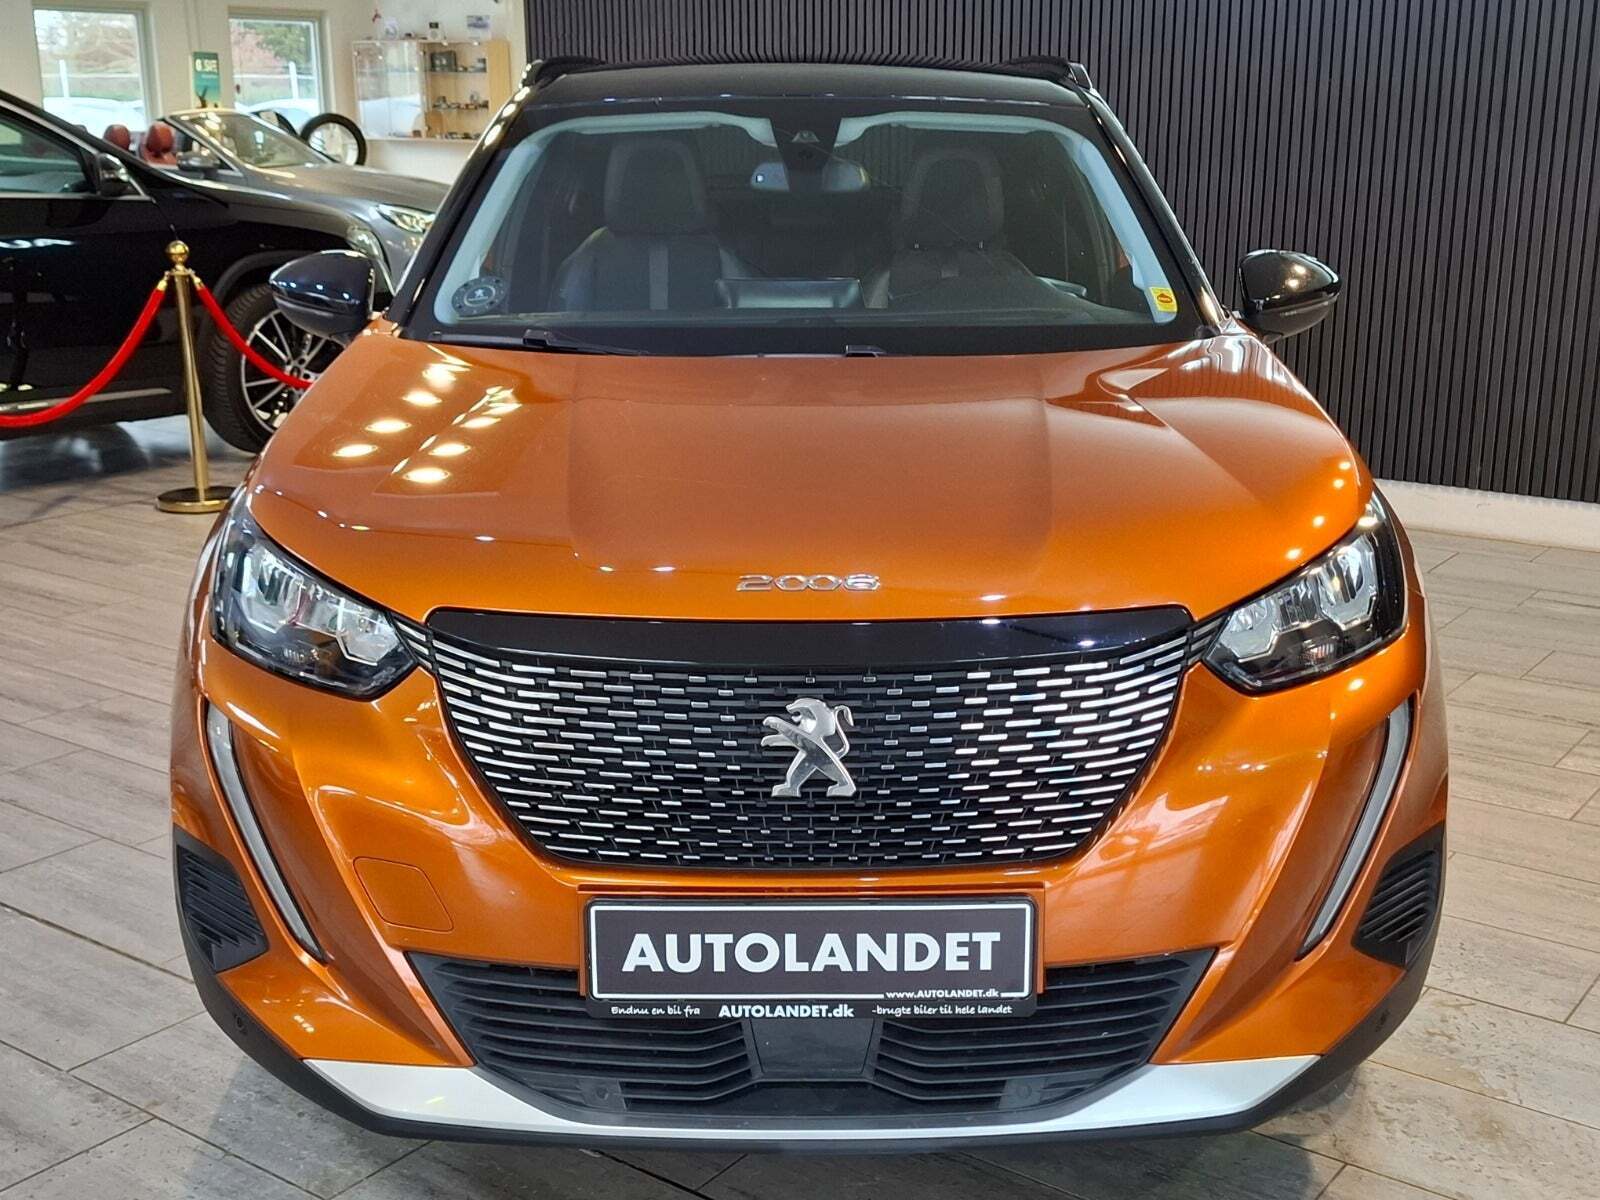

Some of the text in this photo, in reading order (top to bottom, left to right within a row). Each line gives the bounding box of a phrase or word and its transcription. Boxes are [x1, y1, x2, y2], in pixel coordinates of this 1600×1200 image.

[736, 574, 880, 591] 2008
[621, 932, 1001, 973] AUTOLANDET
[885, 989, 1000, 999] www.AUTOLANDET.dk
[611, 1004, 1012, 1018] Endnu en bil fra AUTOLANDET.dk -brugte biler til hele landet
